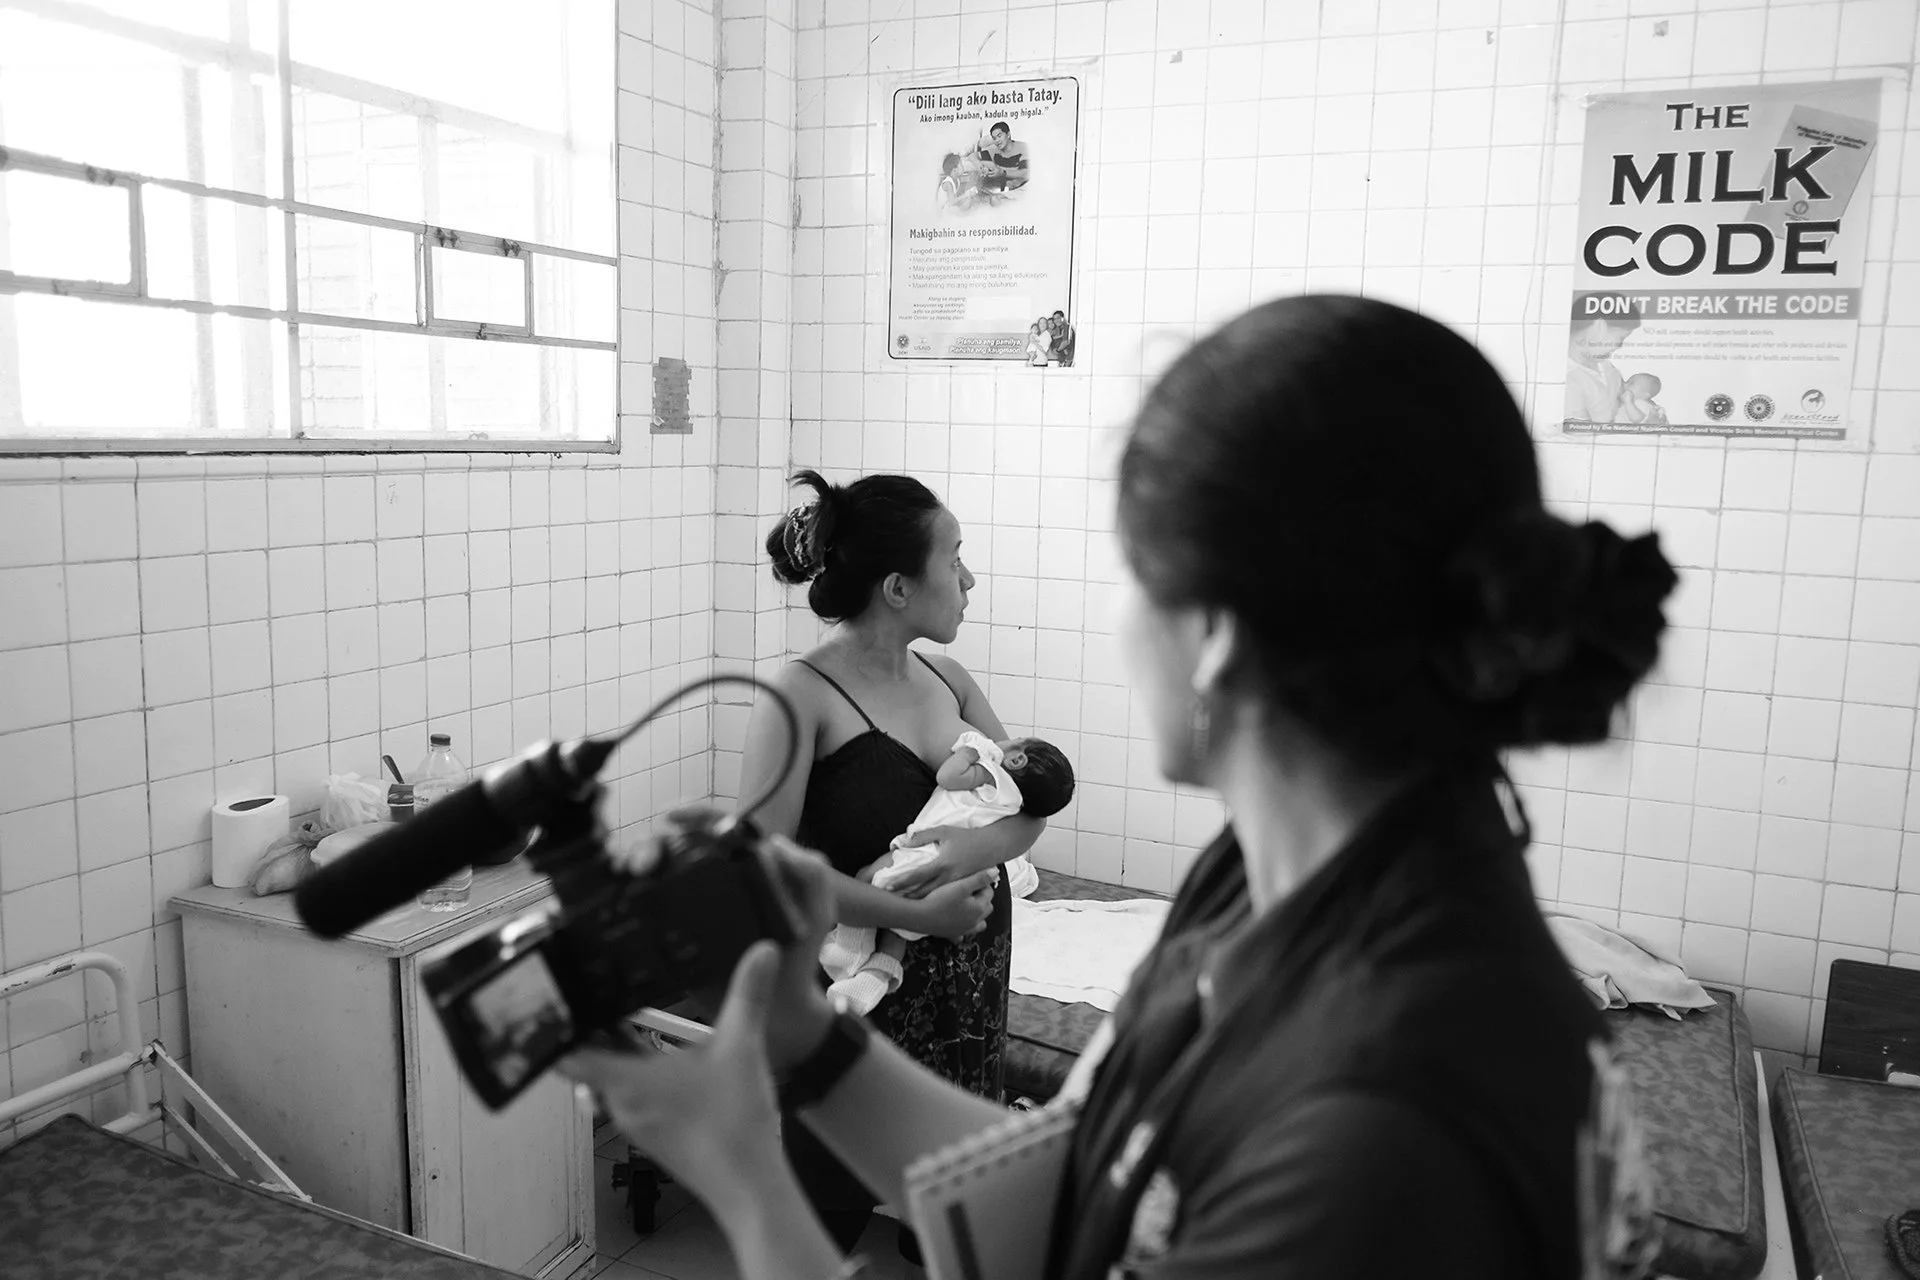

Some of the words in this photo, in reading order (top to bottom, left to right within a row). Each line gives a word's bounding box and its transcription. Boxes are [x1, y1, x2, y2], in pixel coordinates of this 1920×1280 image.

[908, 95, 935, 109] “Dili
[940, 94, 963, 111] lang
[966, 91, 987, 106] ako
[992, 90, 1023, 105] basta
[1028, 88, 1062, 105] Tatay.
[920, 115, 932, 123] Ako
[934, 114, 954, 123] imong
[956, 112, 983, 121] kauban,
[984, 110, 1008, 119] kadula
[1010, 110, 1019, 120] ug
[1666, 102, 1750, 131] THE
[1608, 145, 1836, 206] MILK
[910, 228, 955, 241] Makigbahin
[969, 226, 1038, 239] responsibilidad.
[1583, 218, 1841, 277] CODE
[1584, 296, 1650, 315] DON'T
[1656, 296, 1729, 315] BREAK
[1734, 296, 1778, 315] THE
[1785, 295, 1850, 314] CODE
